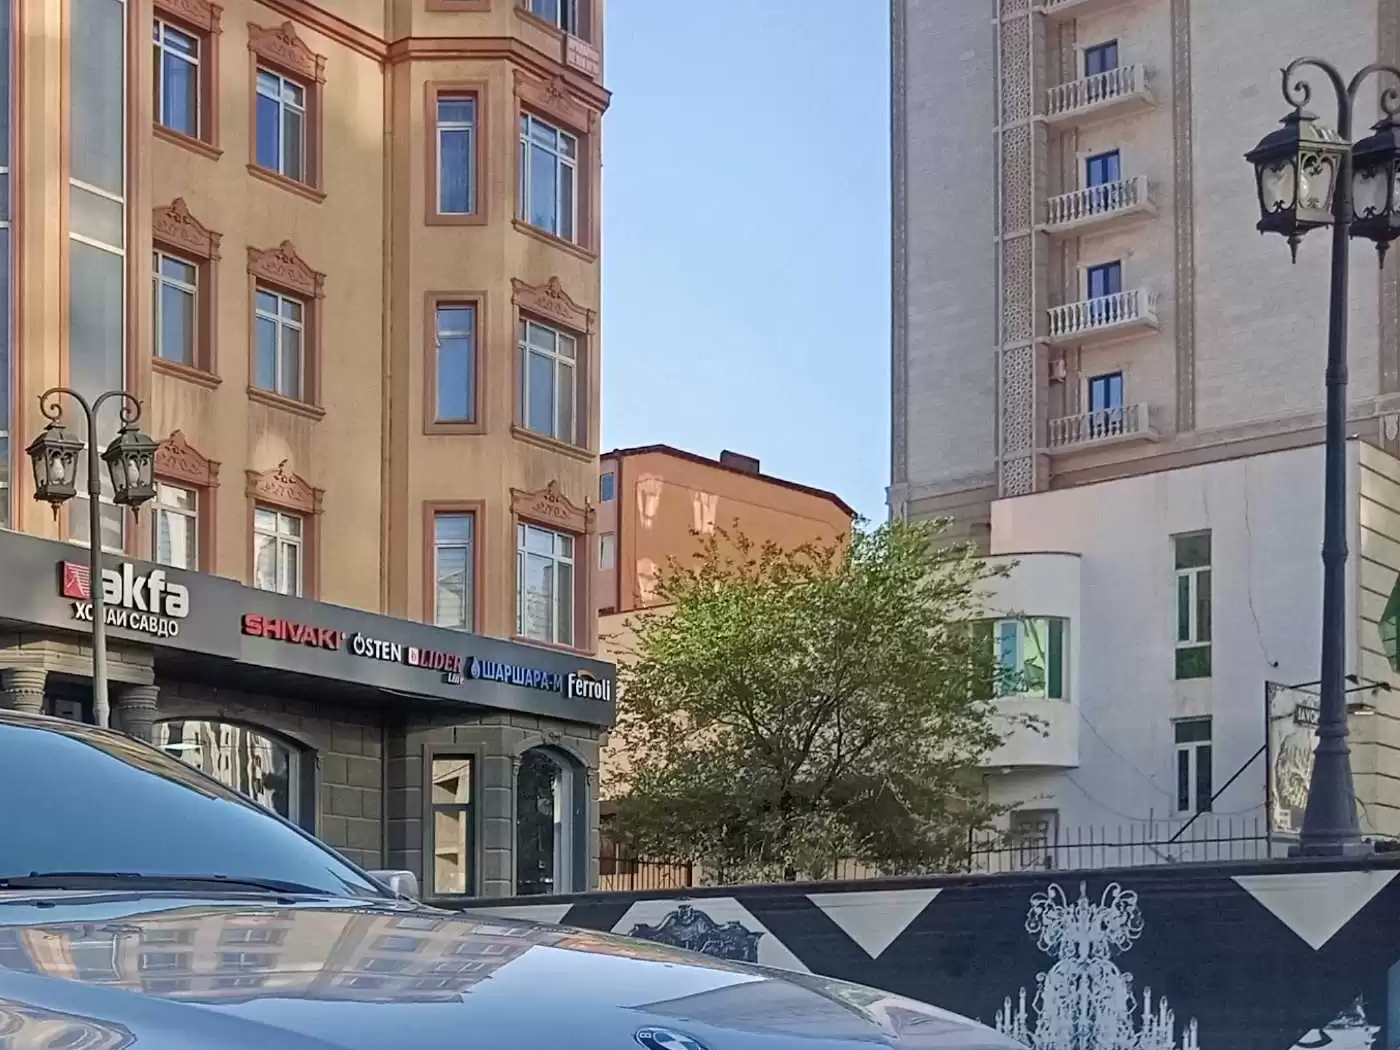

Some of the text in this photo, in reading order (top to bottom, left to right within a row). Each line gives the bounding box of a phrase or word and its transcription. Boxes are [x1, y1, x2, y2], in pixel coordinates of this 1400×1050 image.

[101, 562, 190, 618] akfa
[129, 612, 179, 638] САВДО
[245, 612, 342, 649] SHIVAKI
[482, 659, 563, 693] ШАРШАРА-М
[567, 672, 611, 701] Ferroli
